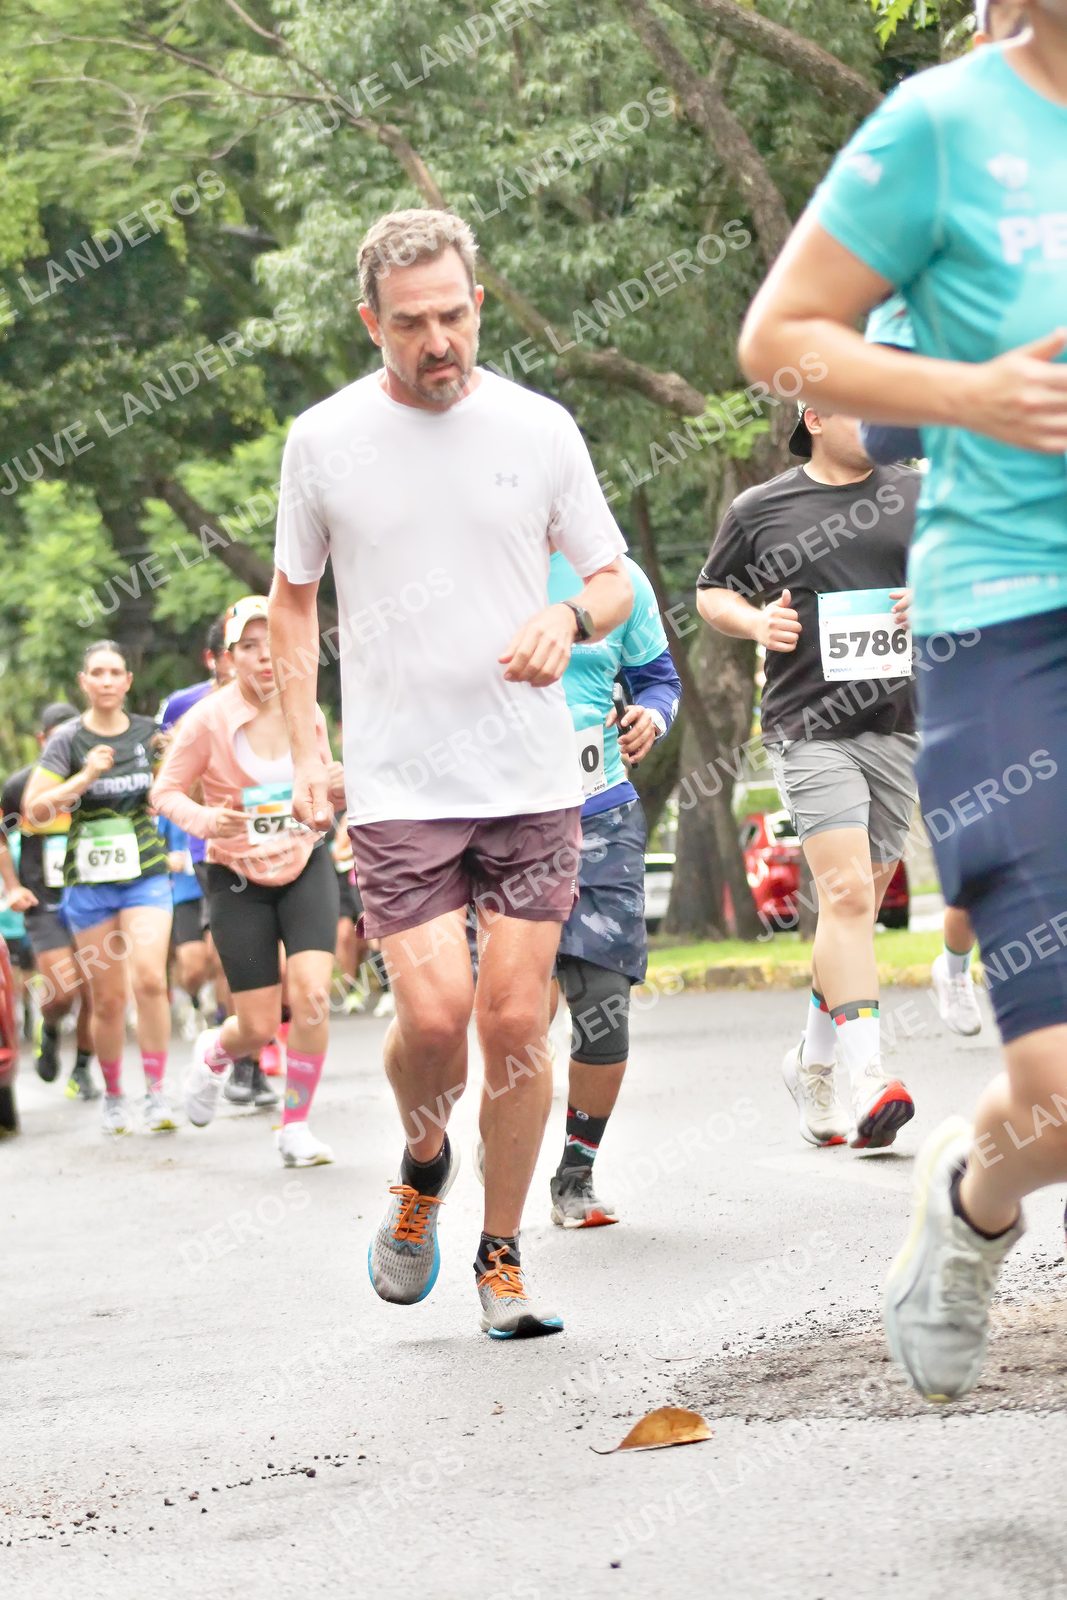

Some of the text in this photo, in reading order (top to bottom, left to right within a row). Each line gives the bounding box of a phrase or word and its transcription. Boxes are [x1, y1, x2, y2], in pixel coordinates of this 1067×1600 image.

[828, 628, 908, 659] 5786
[578, 744, 600, 773] 0
[88, 848, 127, 867] 678
